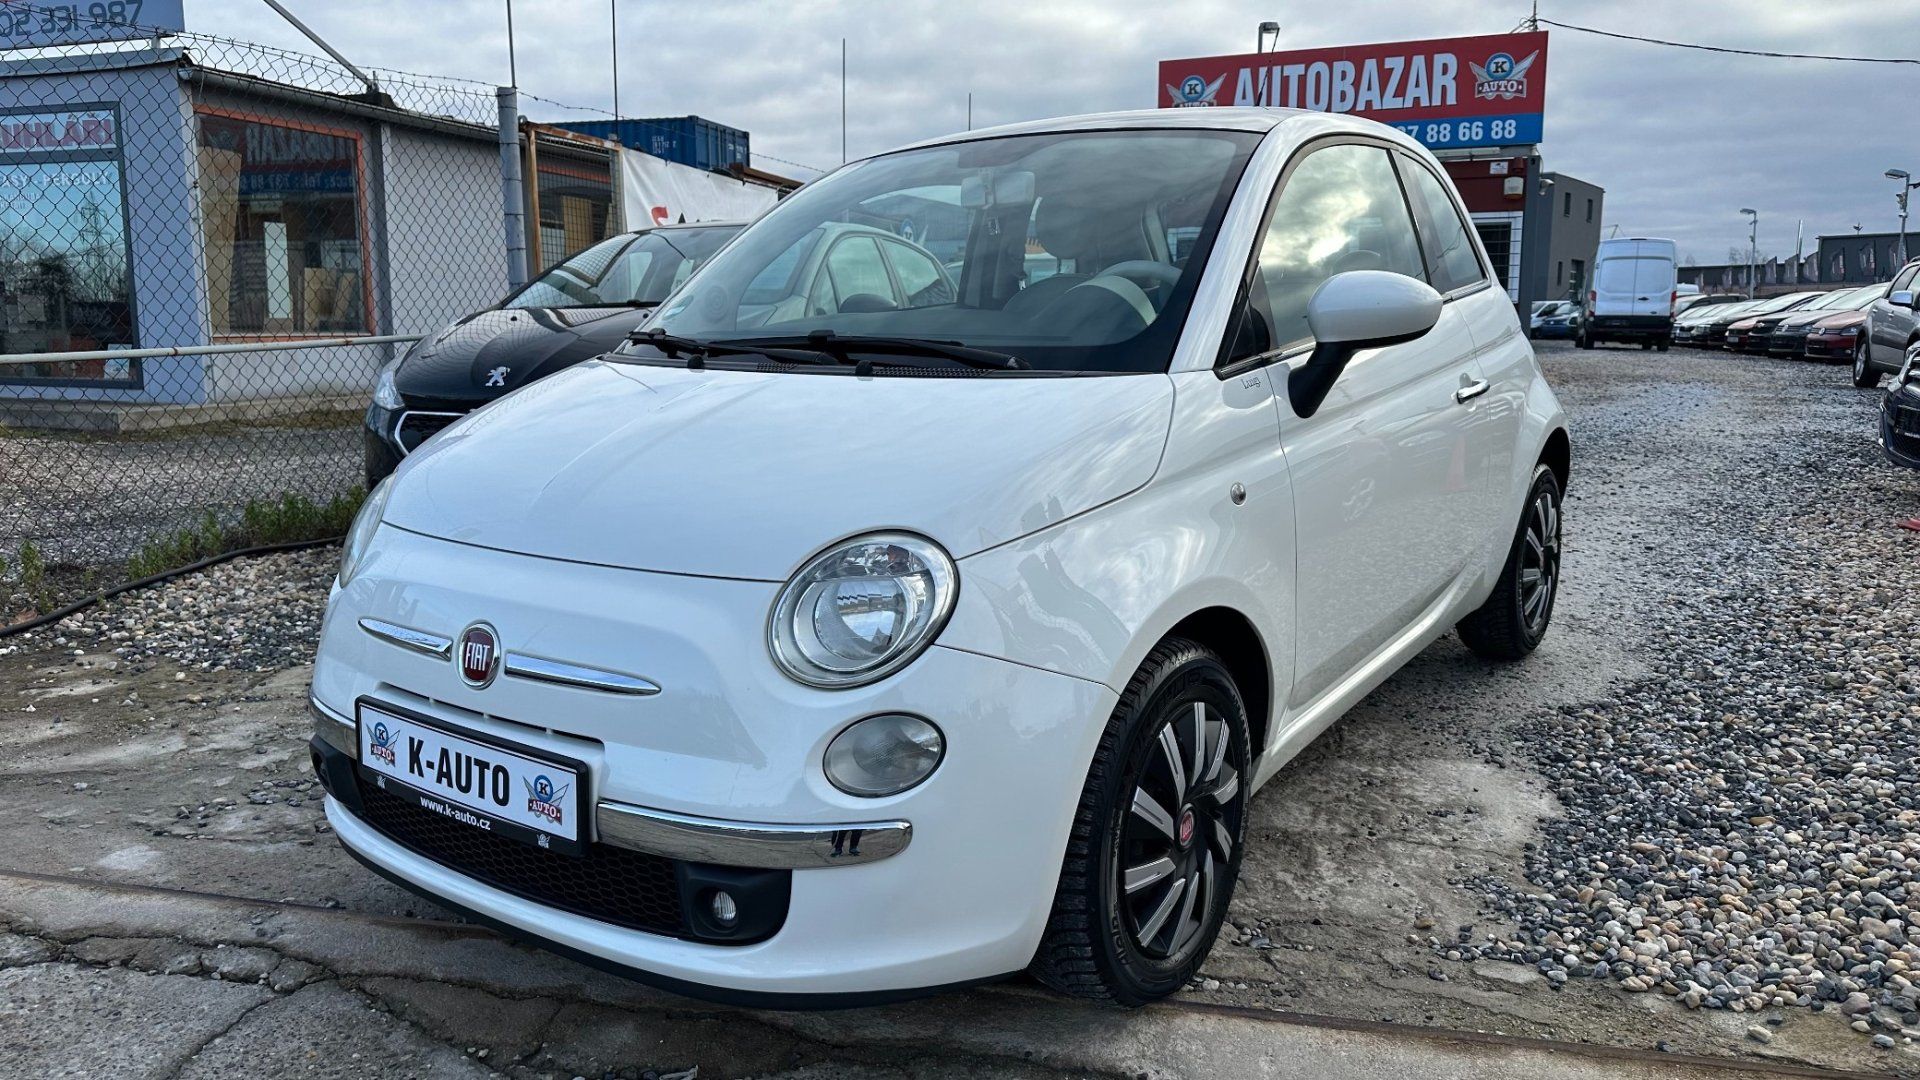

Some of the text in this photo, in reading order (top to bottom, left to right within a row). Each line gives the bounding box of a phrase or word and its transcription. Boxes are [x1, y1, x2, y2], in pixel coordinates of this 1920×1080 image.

[41, 4, 78, 33] 331
[88, 0, 143, 29] 987
[1492, 61, 1507, 73] K
[1187, 83, 1199, 95] K
[1233, 53, 1458, 113] AUTOBAZAR
[1482, 80, 1518, 92] AUTO
[1426, 123, 1451, 143] 88
[1458, 121, 1484, 141] 66
[1491, 119, 1517, 140] 88
[465, 641, 491, 671] FIAT
[408, 736, 510, 807] K-AUTO
[538, 781, 549, 796] K
[420, 797, 491, 830] www.k-auto.cz
[531, 800, 557, 818] AUTO
